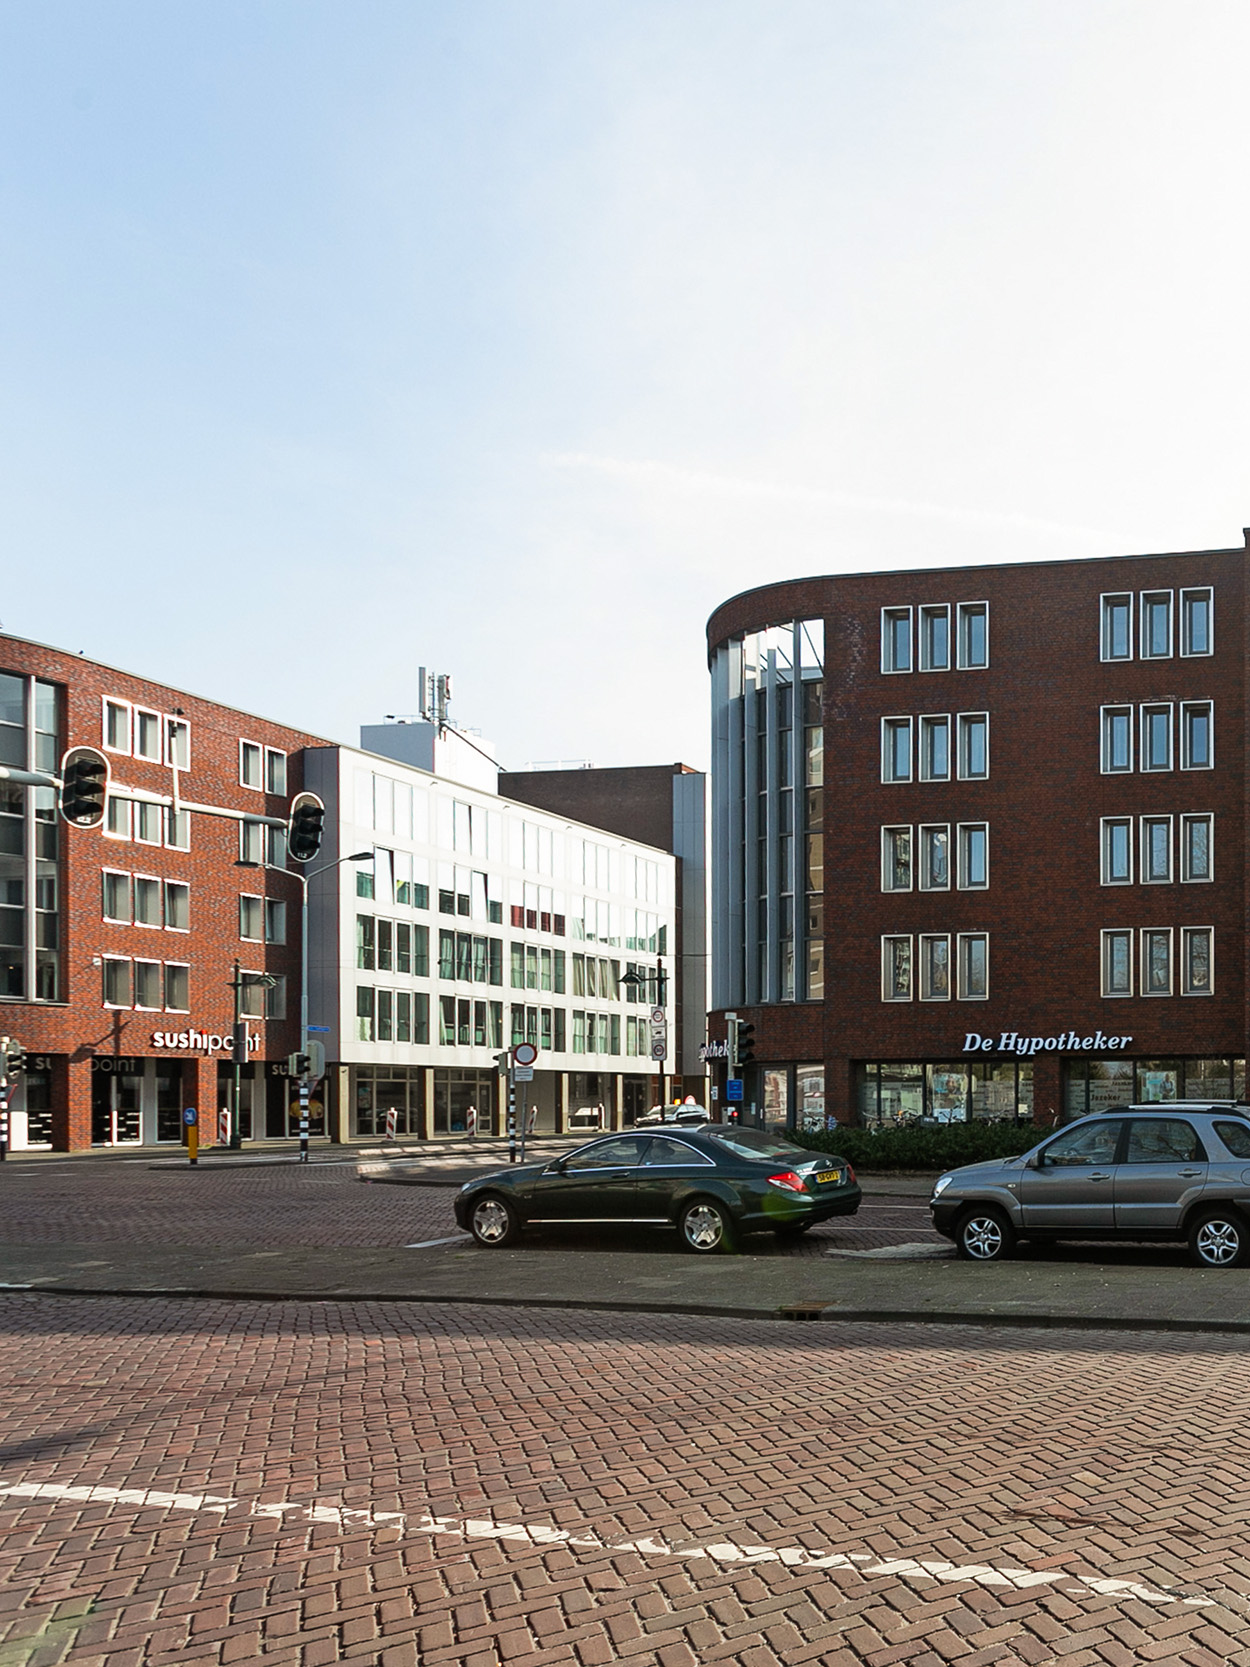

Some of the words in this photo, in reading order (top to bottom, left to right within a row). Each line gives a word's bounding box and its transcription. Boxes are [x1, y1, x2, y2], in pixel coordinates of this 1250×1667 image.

[153, 1029, 261, 1055] sushipont
[963, 1033, 993, 1051] De
[998, 1031, 1133, 1055] Hypotheker
